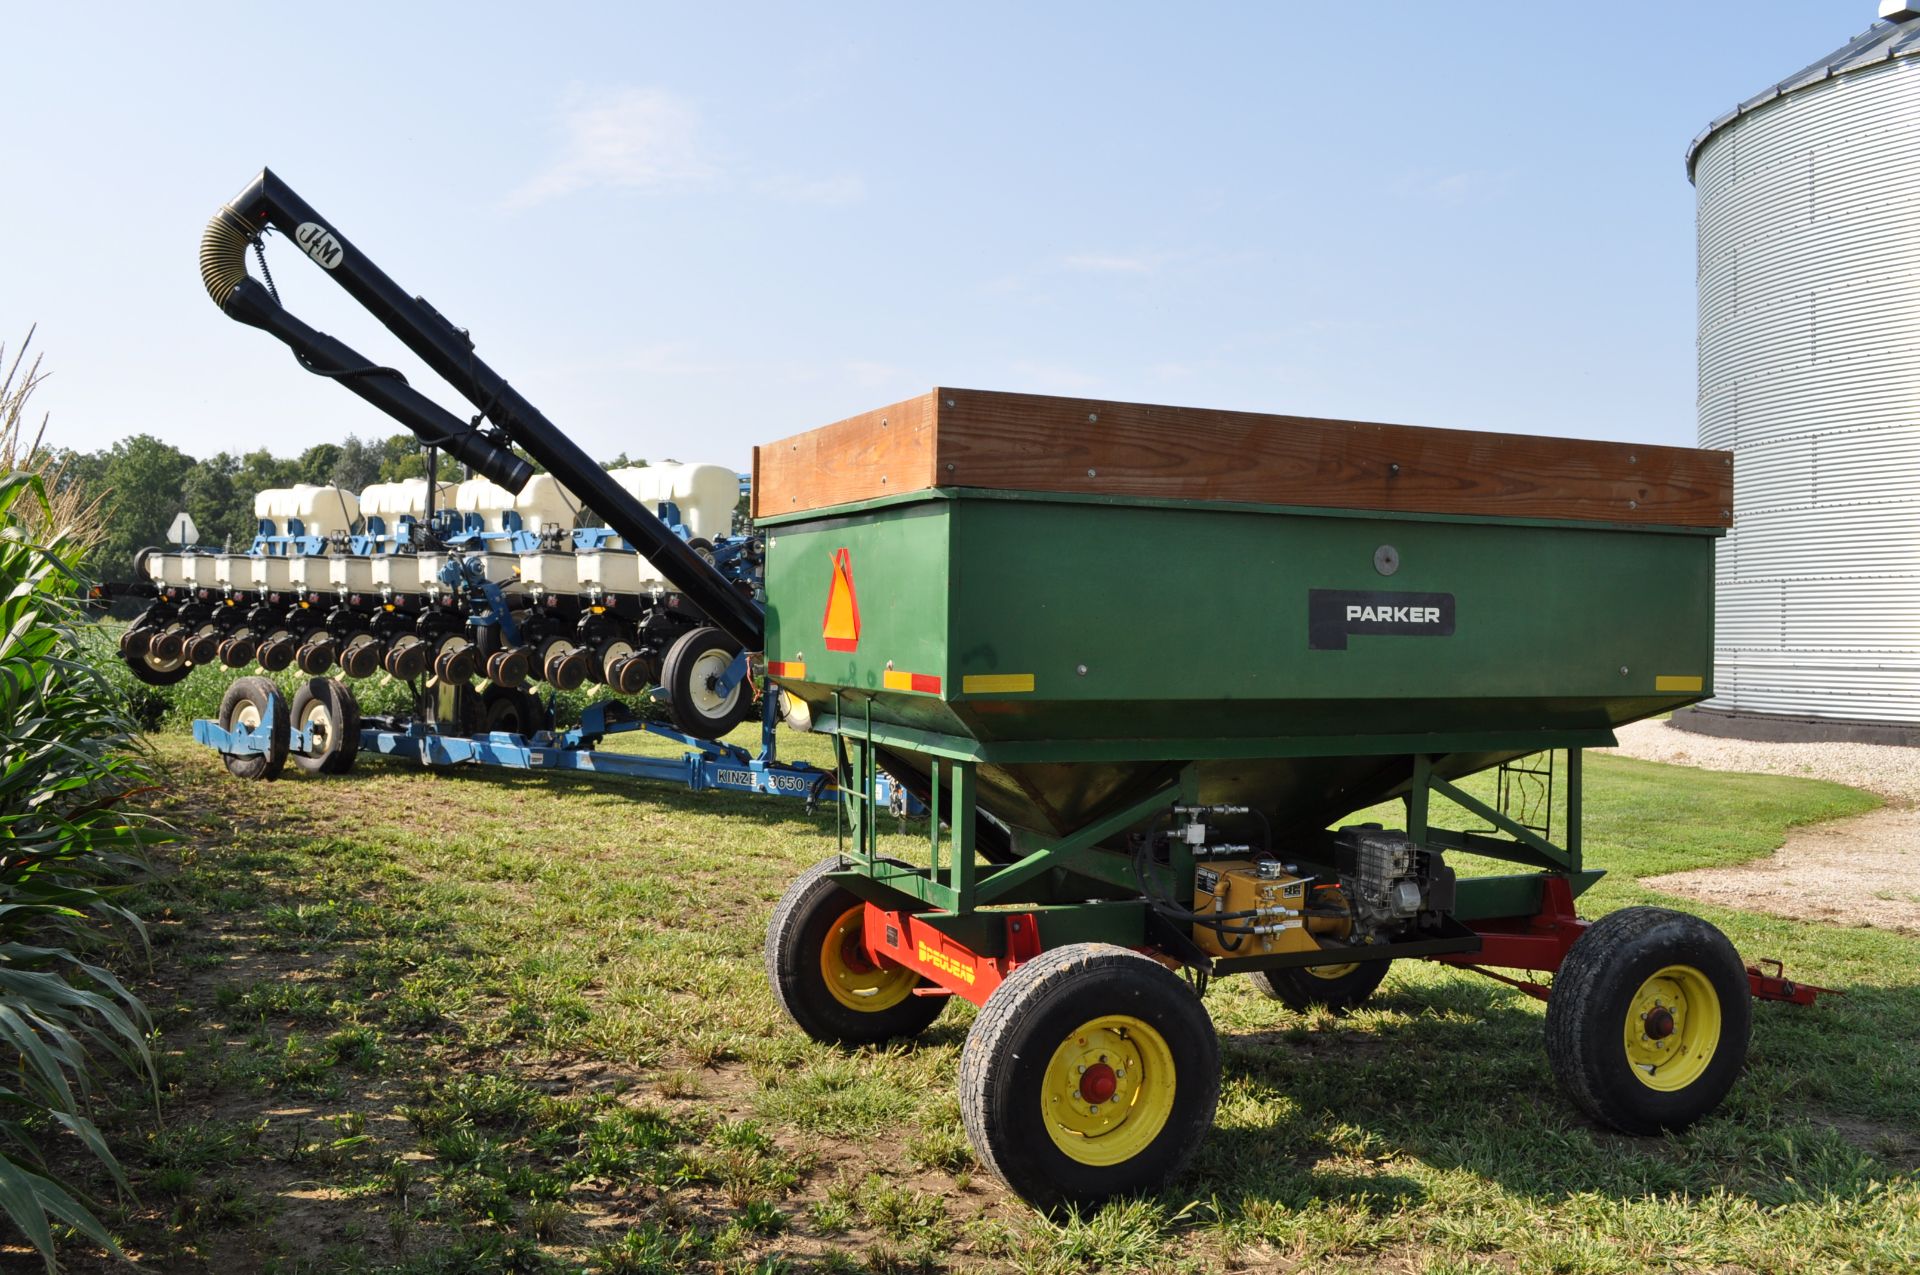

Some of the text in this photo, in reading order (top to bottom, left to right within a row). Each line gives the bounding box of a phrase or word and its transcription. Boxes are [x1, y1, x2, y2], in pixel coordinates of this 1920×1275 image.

[299, 226, 341, 265] J&M
[1346, 605, 1440, 623] PARKER
[717, 768, 757, 786] KINZE
[768, 774, 805, 792] 3650
